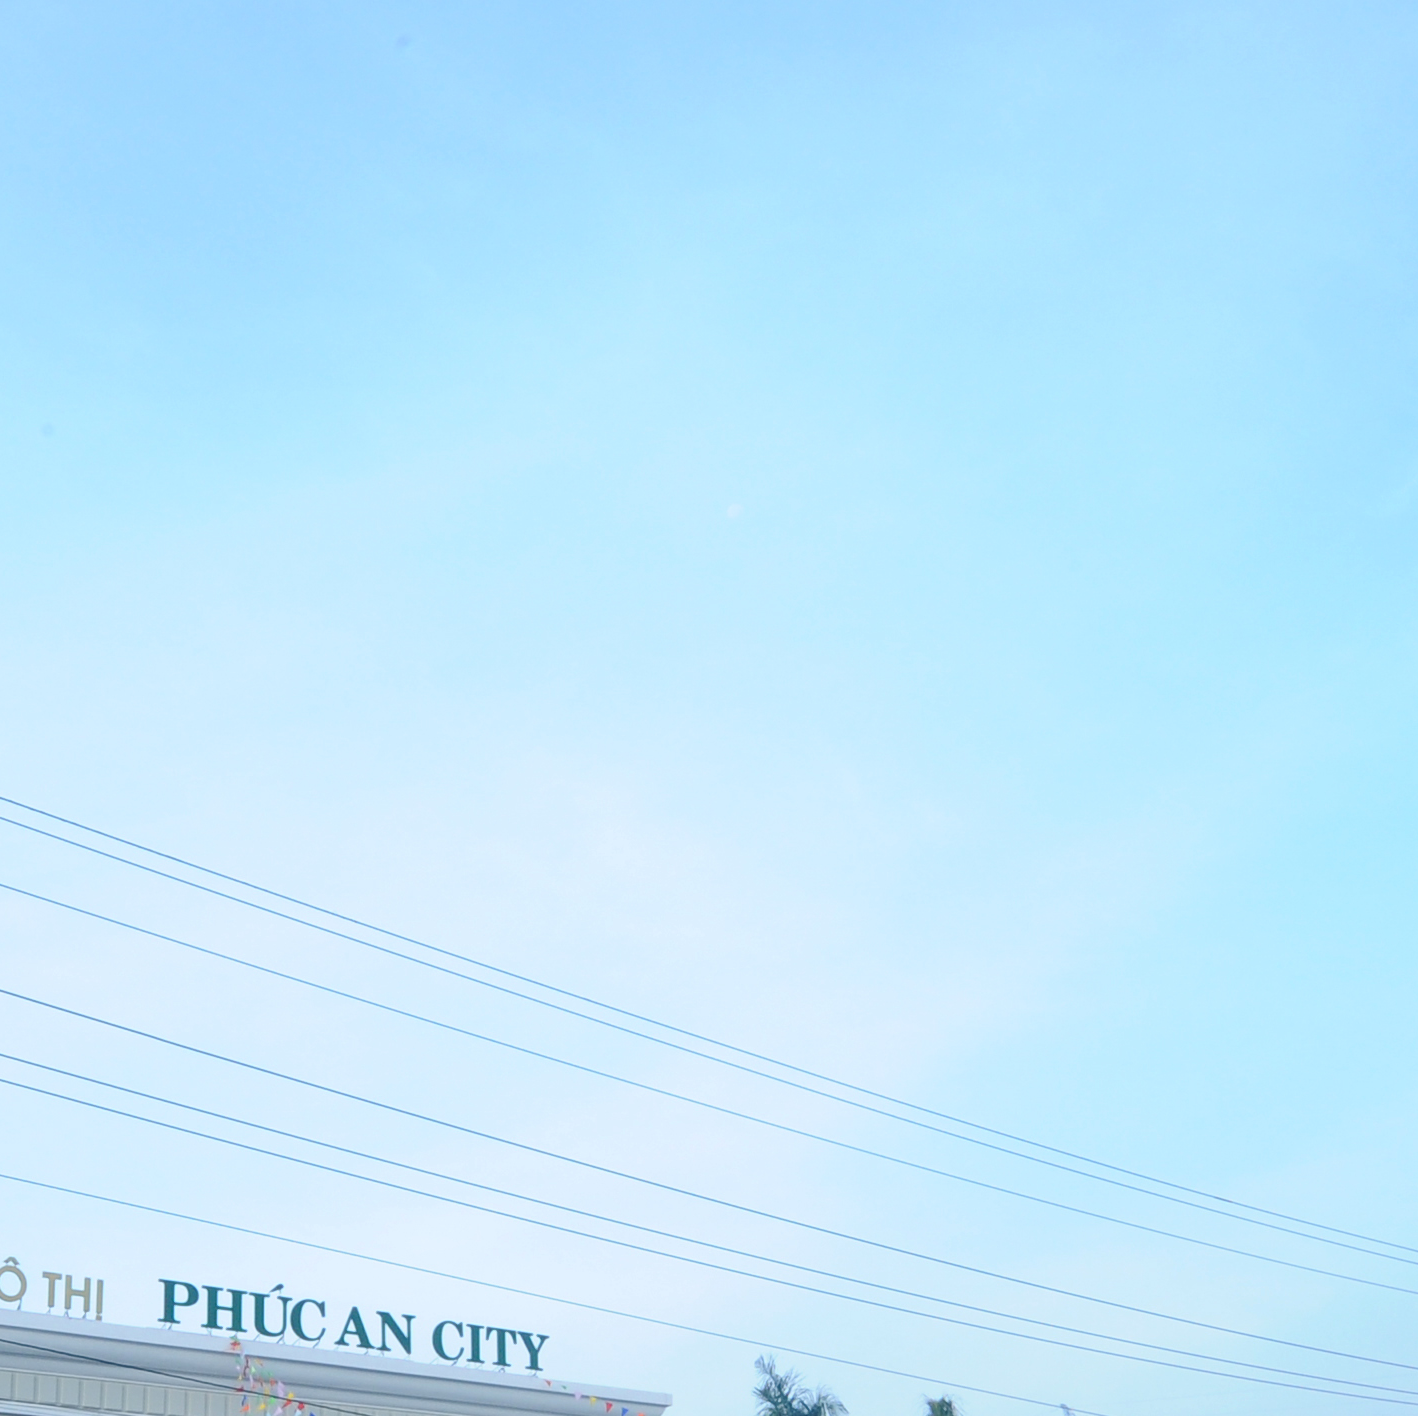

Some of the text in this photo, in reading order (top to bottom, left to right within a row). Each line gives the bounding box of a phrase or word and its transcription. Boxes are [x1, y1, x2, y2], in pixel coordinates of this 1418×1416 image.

[157, 1278, 551, 1371] PHÚC AN CITY
